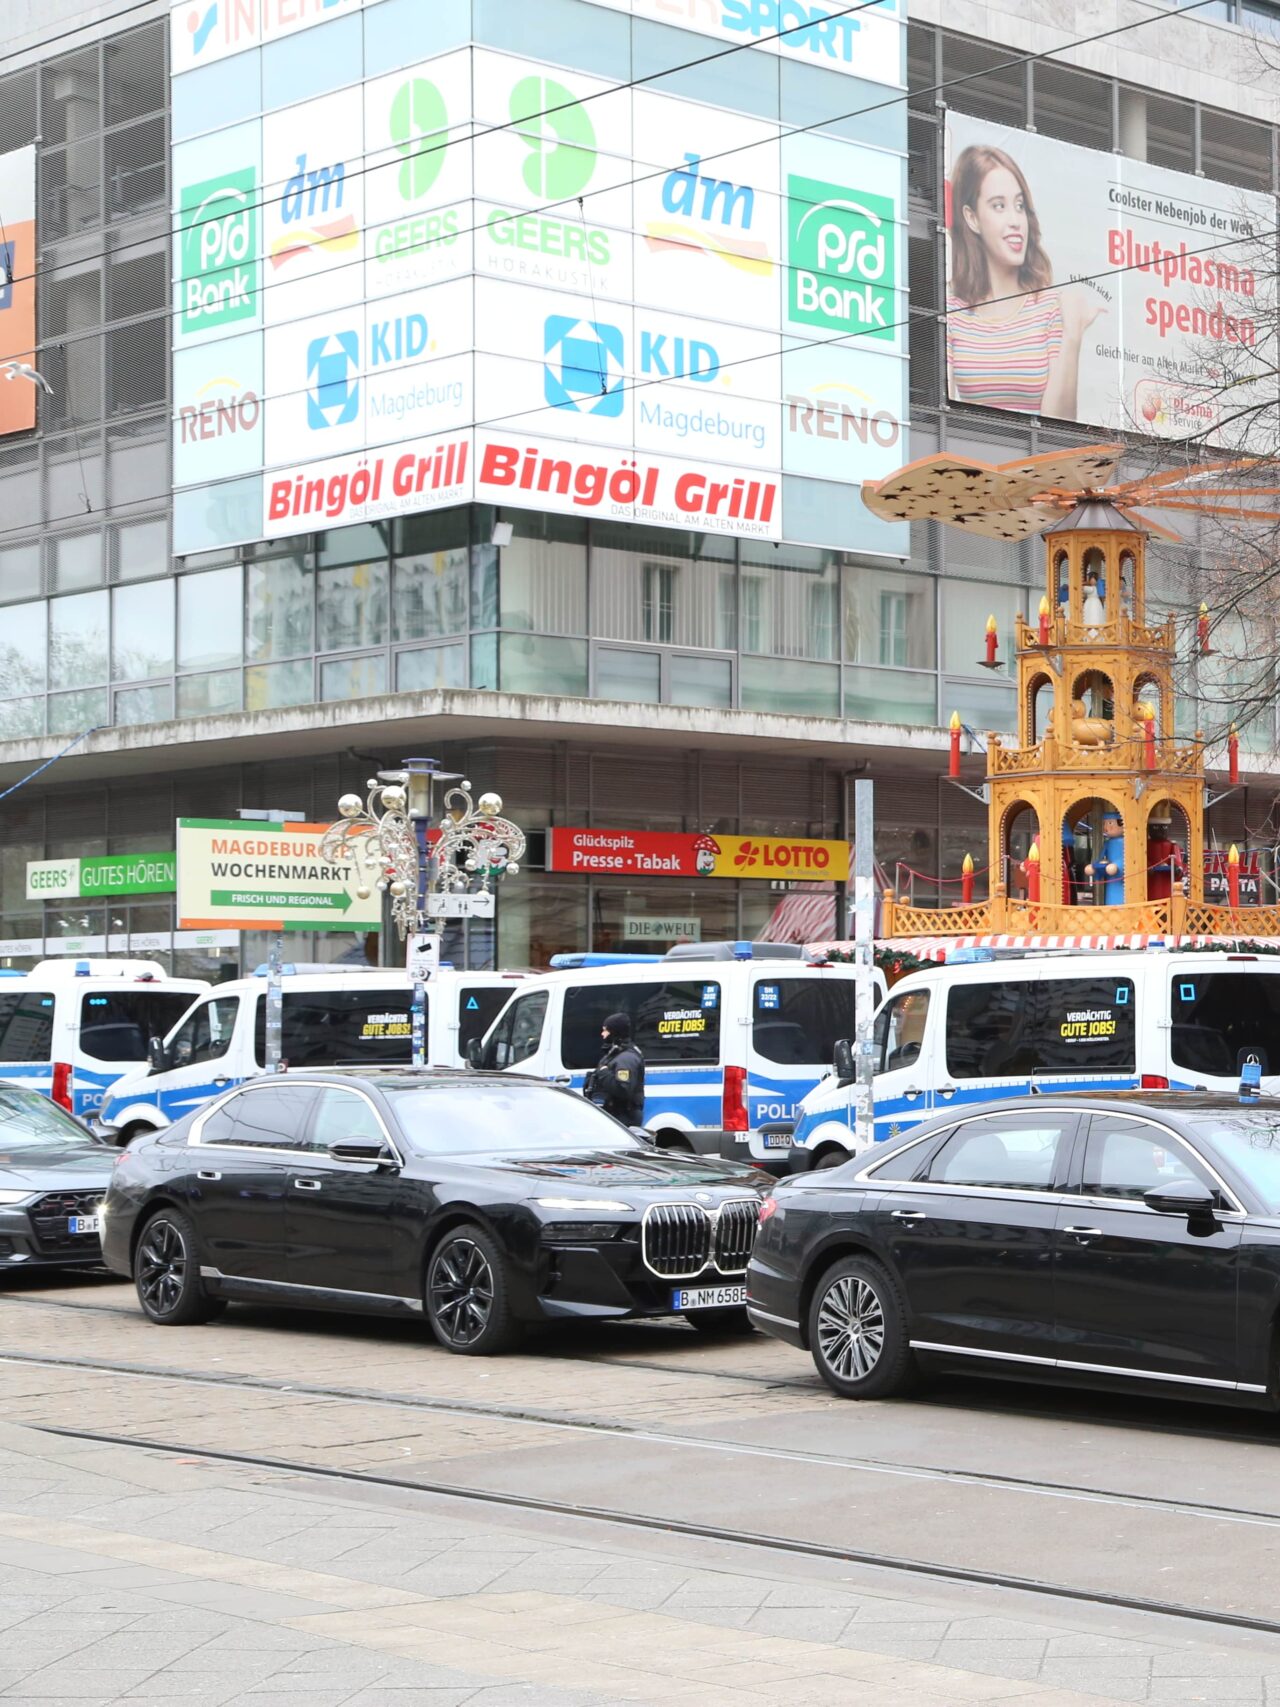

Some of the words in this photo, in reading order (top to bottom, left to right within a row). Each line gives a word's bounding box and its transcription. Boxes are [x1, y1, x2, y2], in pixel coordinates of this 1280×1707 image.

[281, 153, 345, 225] dm
[661, 152, 755, 230] dm
[1109, 188, 1152, 212] Coolster
[1155, 199, 1207, 228] Nebenjob
[1209, 210, 1227, 231] der
[1230, 217, 1255, 237] Welt
[201, 214, 248, 270] psd
[375, 210, 459, 263] GEERS
[487, 209, 611, 265] GEERS
[817, 223, 886, 280] psd
[1108, 228, 1256, 297] Blutplasma
[186, 268, 251, 319] Bank
[796, 270, 889, 326] Bank
[1145, 297, 1256, 347] spenden
[1095, 344, 1121, 359] Gleich
[1123, 348, 1140, 363] hier
[1141, 355, 1155, 366] am
[1157, 355, 1178, 371] Alten
[1180, 360, 1204, 376] Markt
[370, 380, 463, 421] Magdeburg
[179, 391, 260, 445] RENO
[640, 400, 766, 448] Magdeburg
[784, 394, 900, 448] RENO
[1173, 413, 1202, 430] Service
[268, 459, 384, 520] Bingöl
[392, 440, 469, 497] Grill
[479, 444, 659, 506] Bingöl
[675, 472, 776, 523] Grill
[611, 504, 631, 517] DAS
[635, 508, 681, 524] ORIGINAL
[684, 514, 700, 525] AM
[703, 516, 734, 530] ALTEN
[736, 521, 769, 535] MARKT
[573, 834, 635, 851] Glückspilz
[763, 844, 830, 868] LOTTO
[30, 869, 67, 889] GEERS
[82, 865, 124, 887] GUTES
[126, 860, 174, 885] HÖREN
[211, 862, 352, 881] WOCHENMARKT
[572, 851, 624, 868] Presse
[634, 853, 681, 870] Tabak
[1203, 849, 1260, 875] GRLL
[231, 893, 264, 904] FRISCH
[265, 894, 286, 905] UND
[288, 895, 334, 906] REGIONAL
[1210, 877, 1258, 892] PATA
[629, 921, 651, 935] DIE
[663, 922, 697, 936] WELT
[362, 1023, 385, 1035] GUTE
[386, 1023, 411, 1035] JOBS!
[658, 1020, 681, 1033] GUTE
[682, 1019, 705, 1032] JOBS!
[1060, 1022, 1088, 1037] GUTE
[1088, 1020, 1116, 1037] JOBS!
[1066, 1009, 1112, 1022] VERDÄCHTIG
[77, 1219, 86, 1231] B
[681, 1291, 689, 1307] B
[698, 1290, 715, 1304] NM
